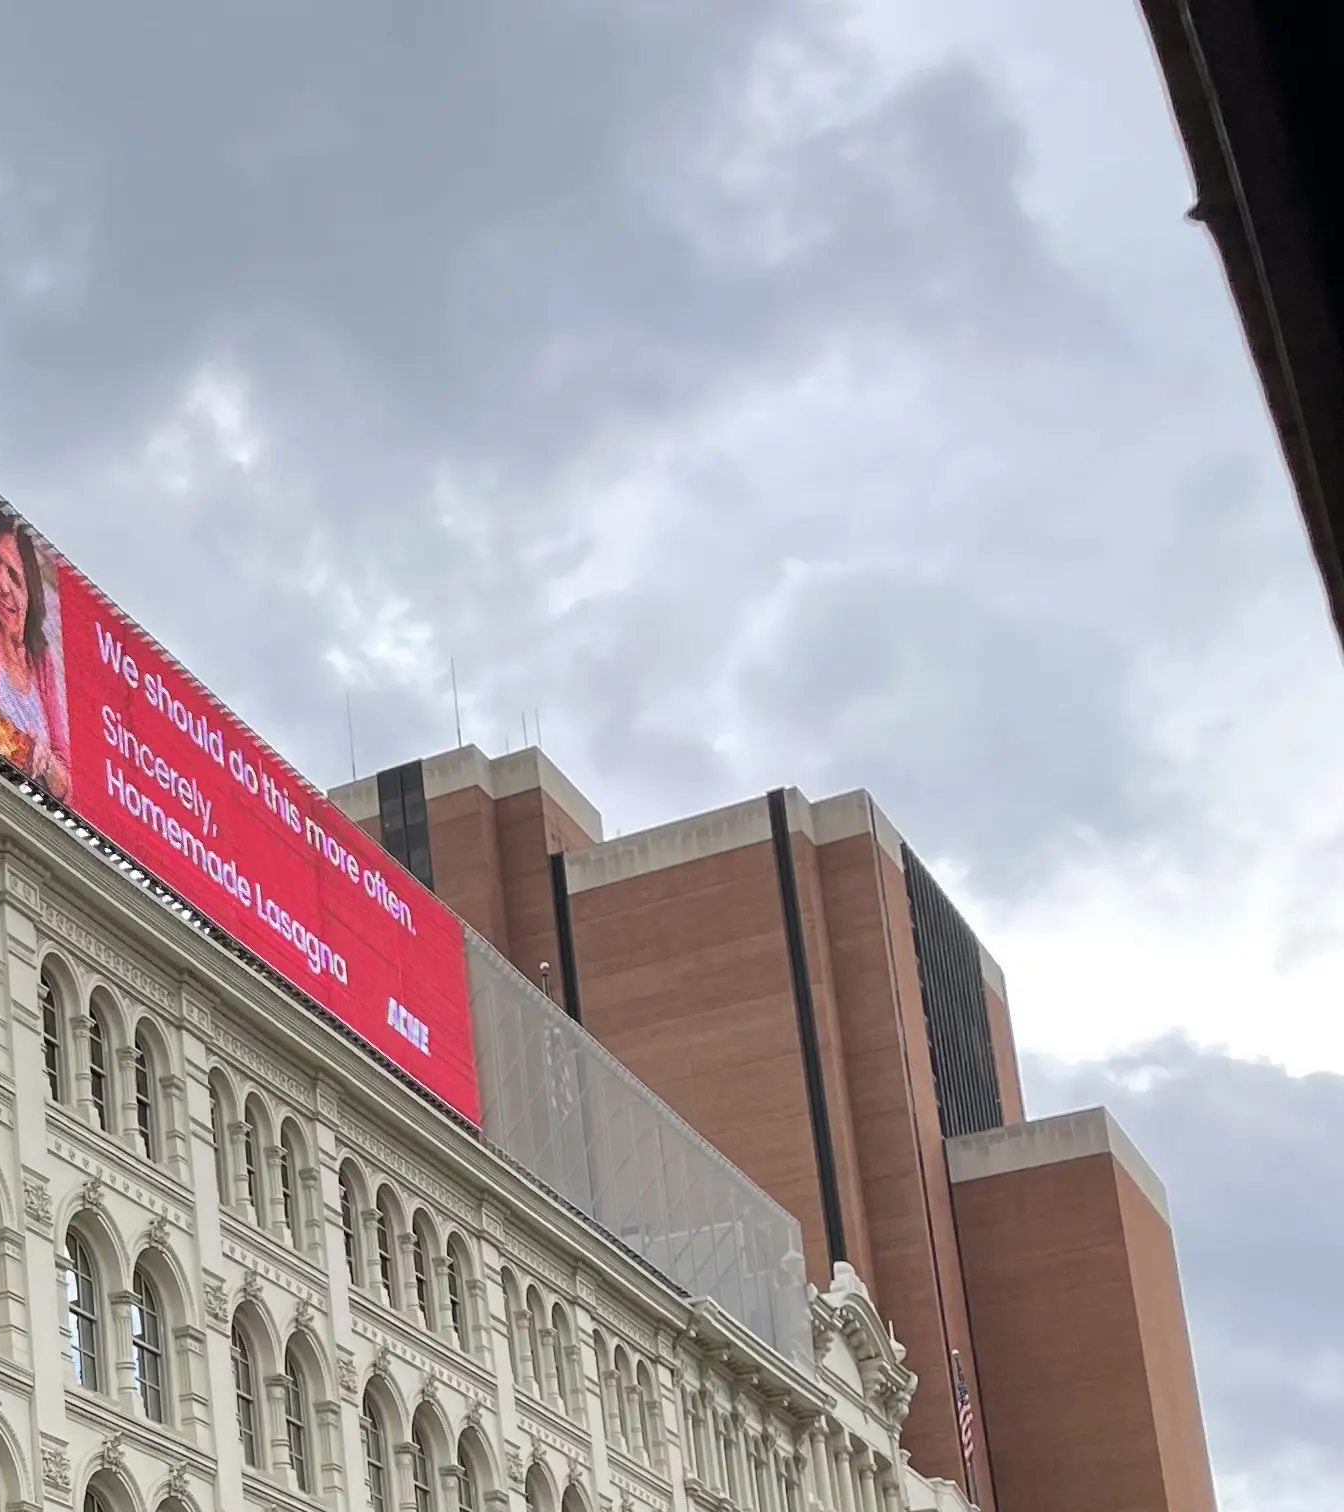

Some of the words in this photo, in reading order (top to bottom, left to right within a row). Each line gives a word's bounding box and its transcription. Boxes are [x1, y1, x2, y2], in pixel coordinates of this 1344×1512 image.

[95, 621, 139, 688] We
[144, 673, 225, 768] should
[229, 749, 260, 796] do
[260, 771, 302, 834] this
[304, 815, 360, 884] more
[363, 869, 417, 935] often.
[101, 705, 218, 838] Sincerely,
[105, 758, 251, 907] Homemade
[255, 883, 348, 985] Lasagna
[387, 996, 431, 1055] ACME
